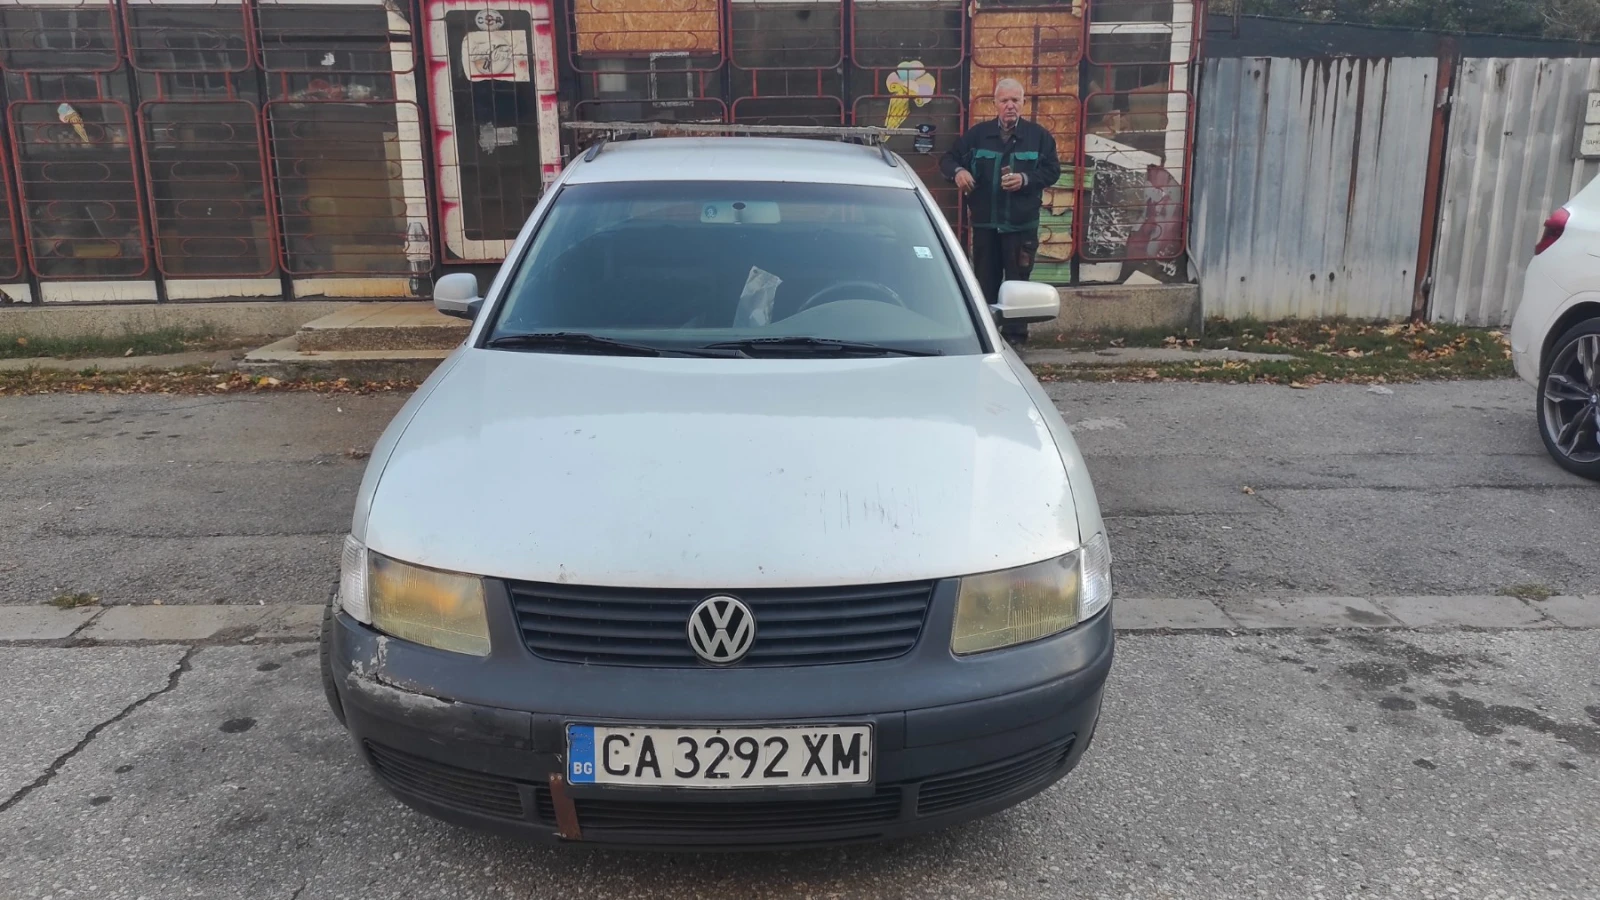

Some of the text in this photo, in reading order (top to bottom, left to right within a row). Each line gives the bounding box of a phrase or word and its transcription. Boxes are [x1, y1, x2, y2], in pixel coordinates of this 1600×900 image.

[690, 598, 754, 660] VW
[573, 762, 593, 774] BG
[603, 732, 863, 779] CA 3292 XM
